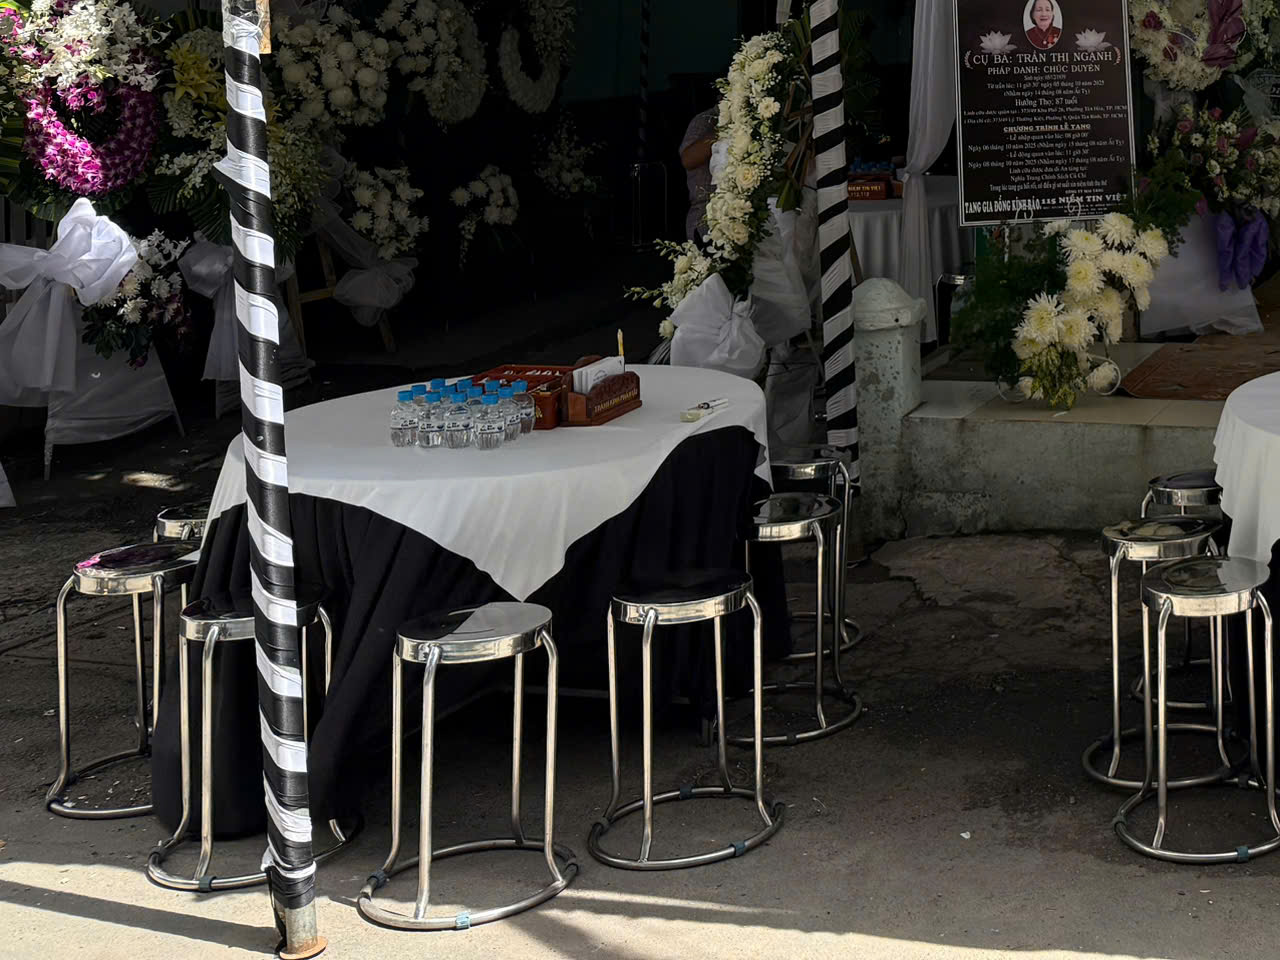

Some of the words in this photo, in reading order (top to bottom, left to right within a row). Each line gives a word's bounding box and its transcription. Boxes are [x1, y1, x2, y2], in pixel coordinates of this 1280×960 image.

[973, 54, 989, 66] CỤ
[1050, 52, 1069, 64] THỊ
[1074, 51, 1112, 63] NGẠNH
[988, 65, 1011, 75] PHÁP
[1013, 66, 1041, 74] DANH:
[1043, 63, 1068, 73] CHÚC
[1071, 63, 1100, 73] DUYÊN
[1055, 97, 1063, 105] 87
[1085, 195, 1103, 203] TIN
[965, 202, 981, 214] TANG
[982, 200, 993, 213] GIA
